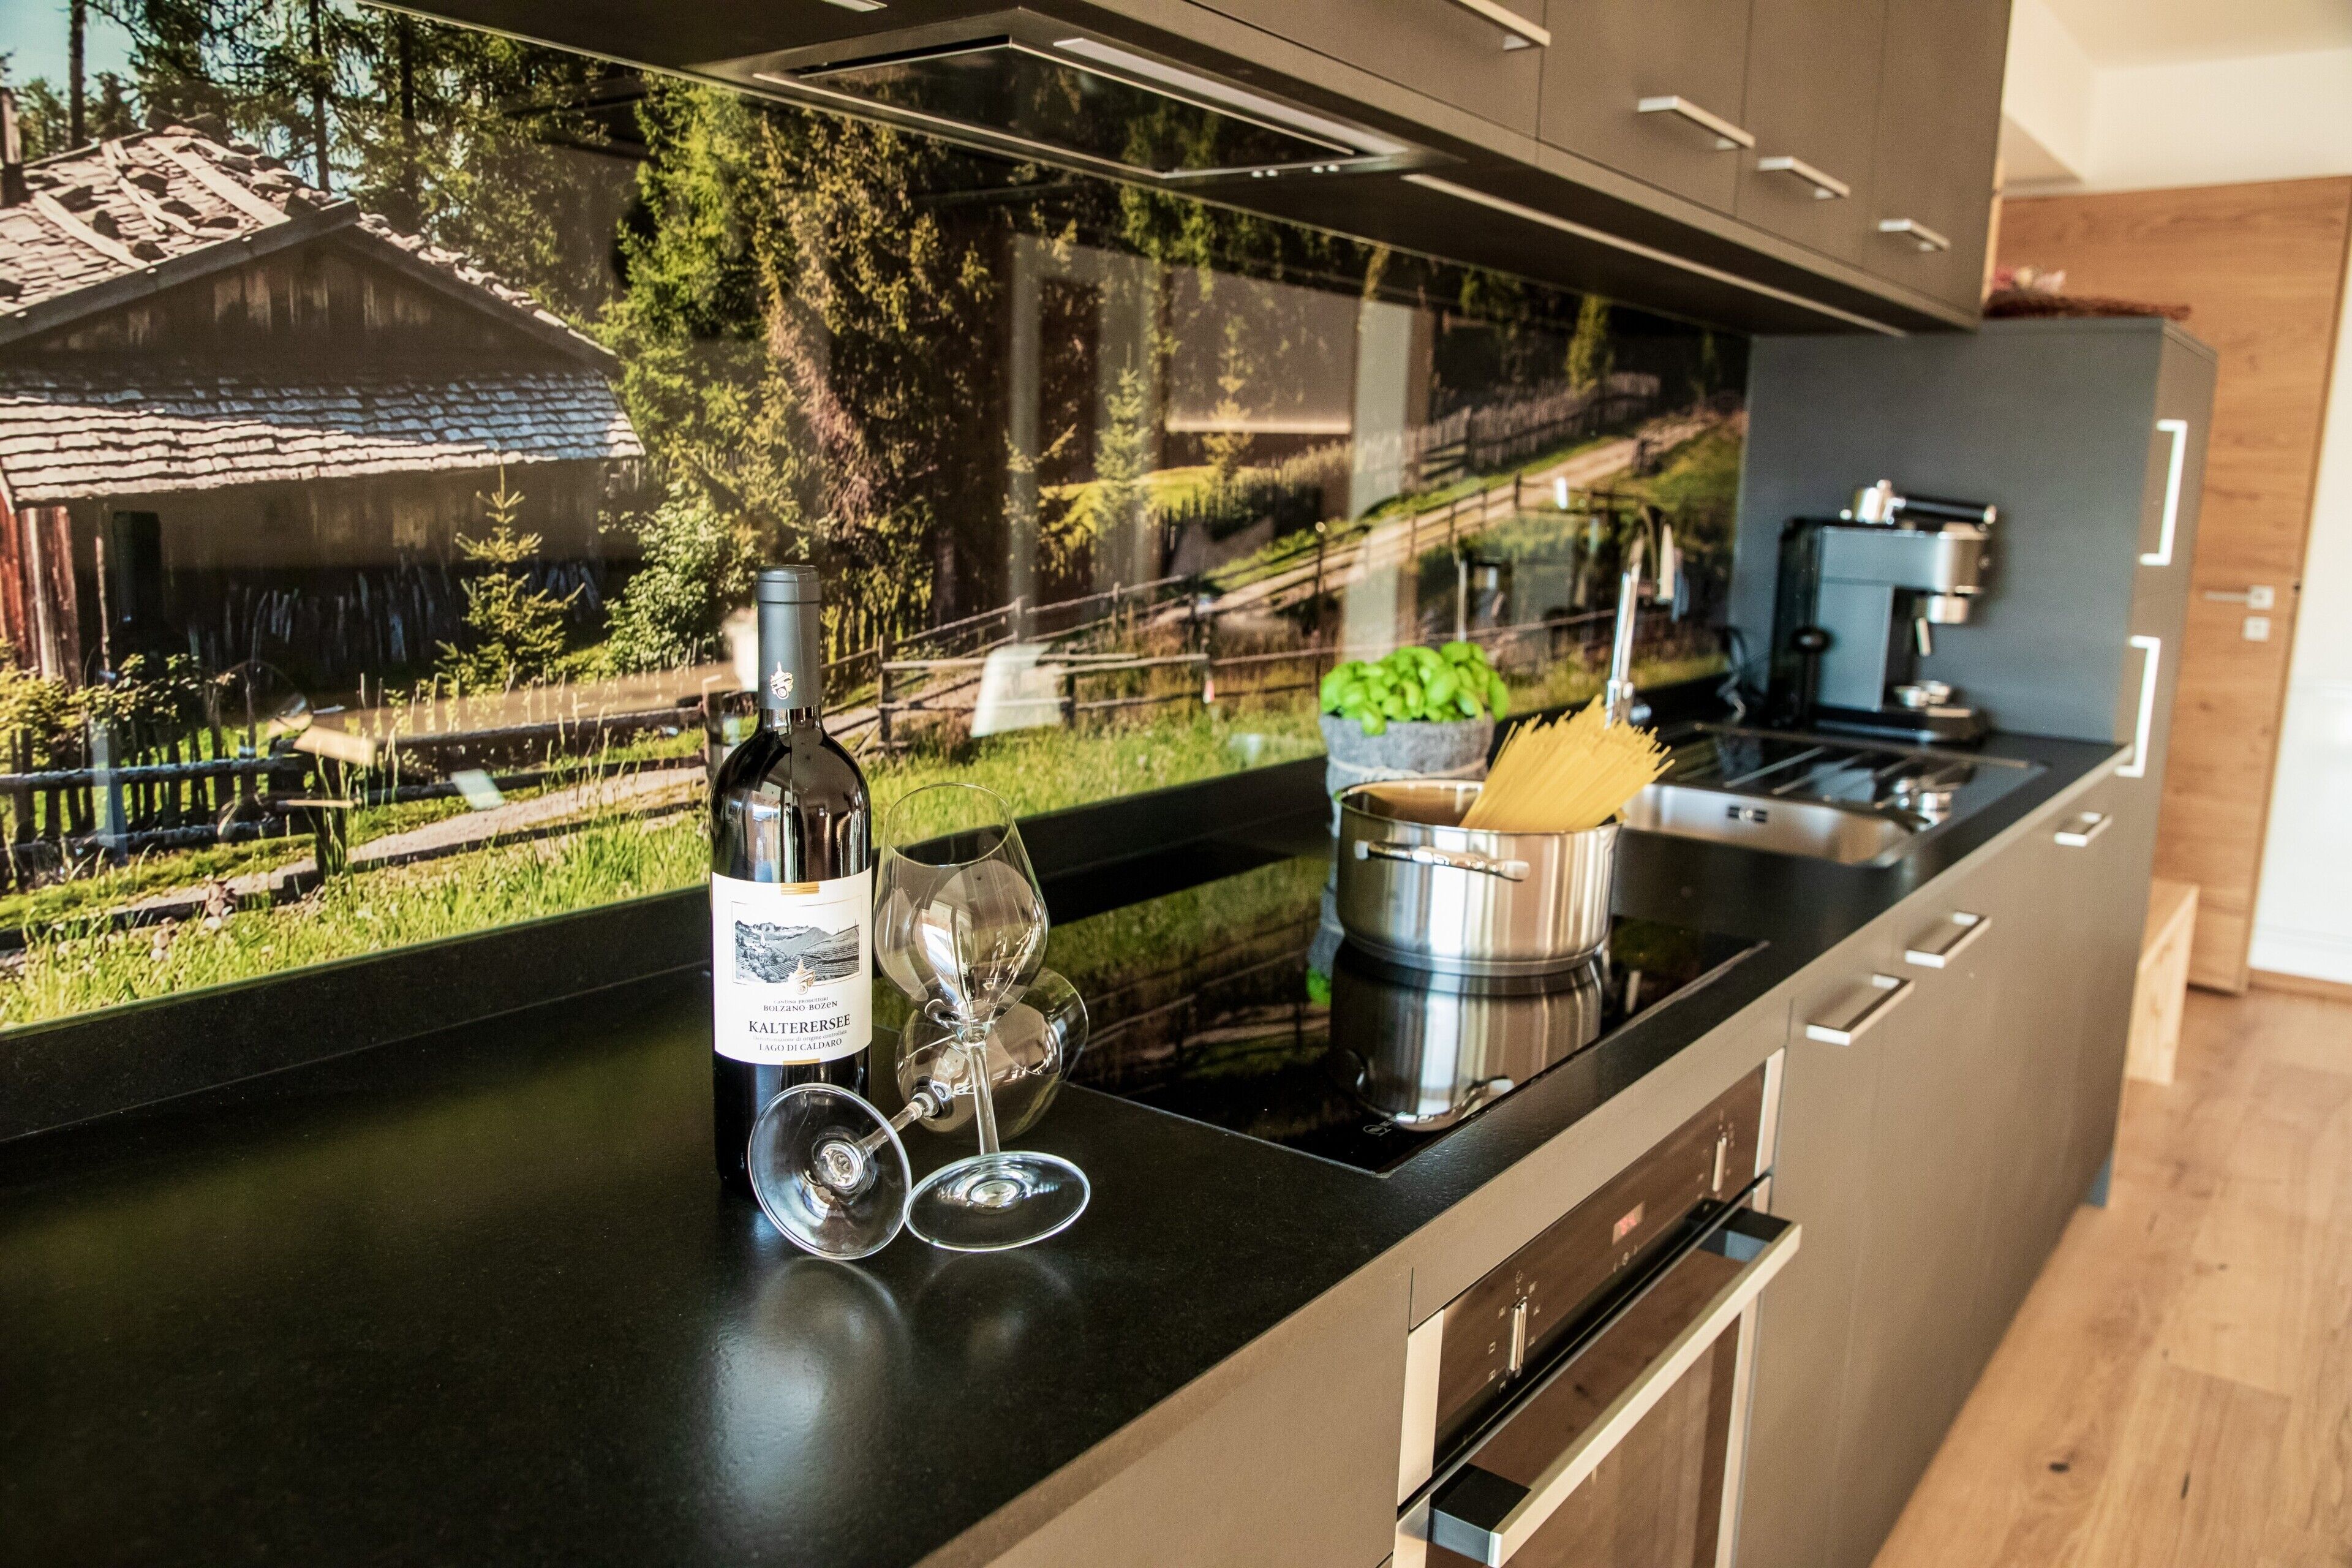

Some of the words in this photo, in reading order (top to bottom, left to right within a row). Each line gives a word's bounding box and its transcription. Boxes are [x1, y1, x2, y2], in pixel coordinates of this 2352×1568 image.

[749, 1014, 851, 1034] KALTERERSEE
[823, 1030, 847, 1039] controllata
[800, 1038, 842, 1051] CALDARO
